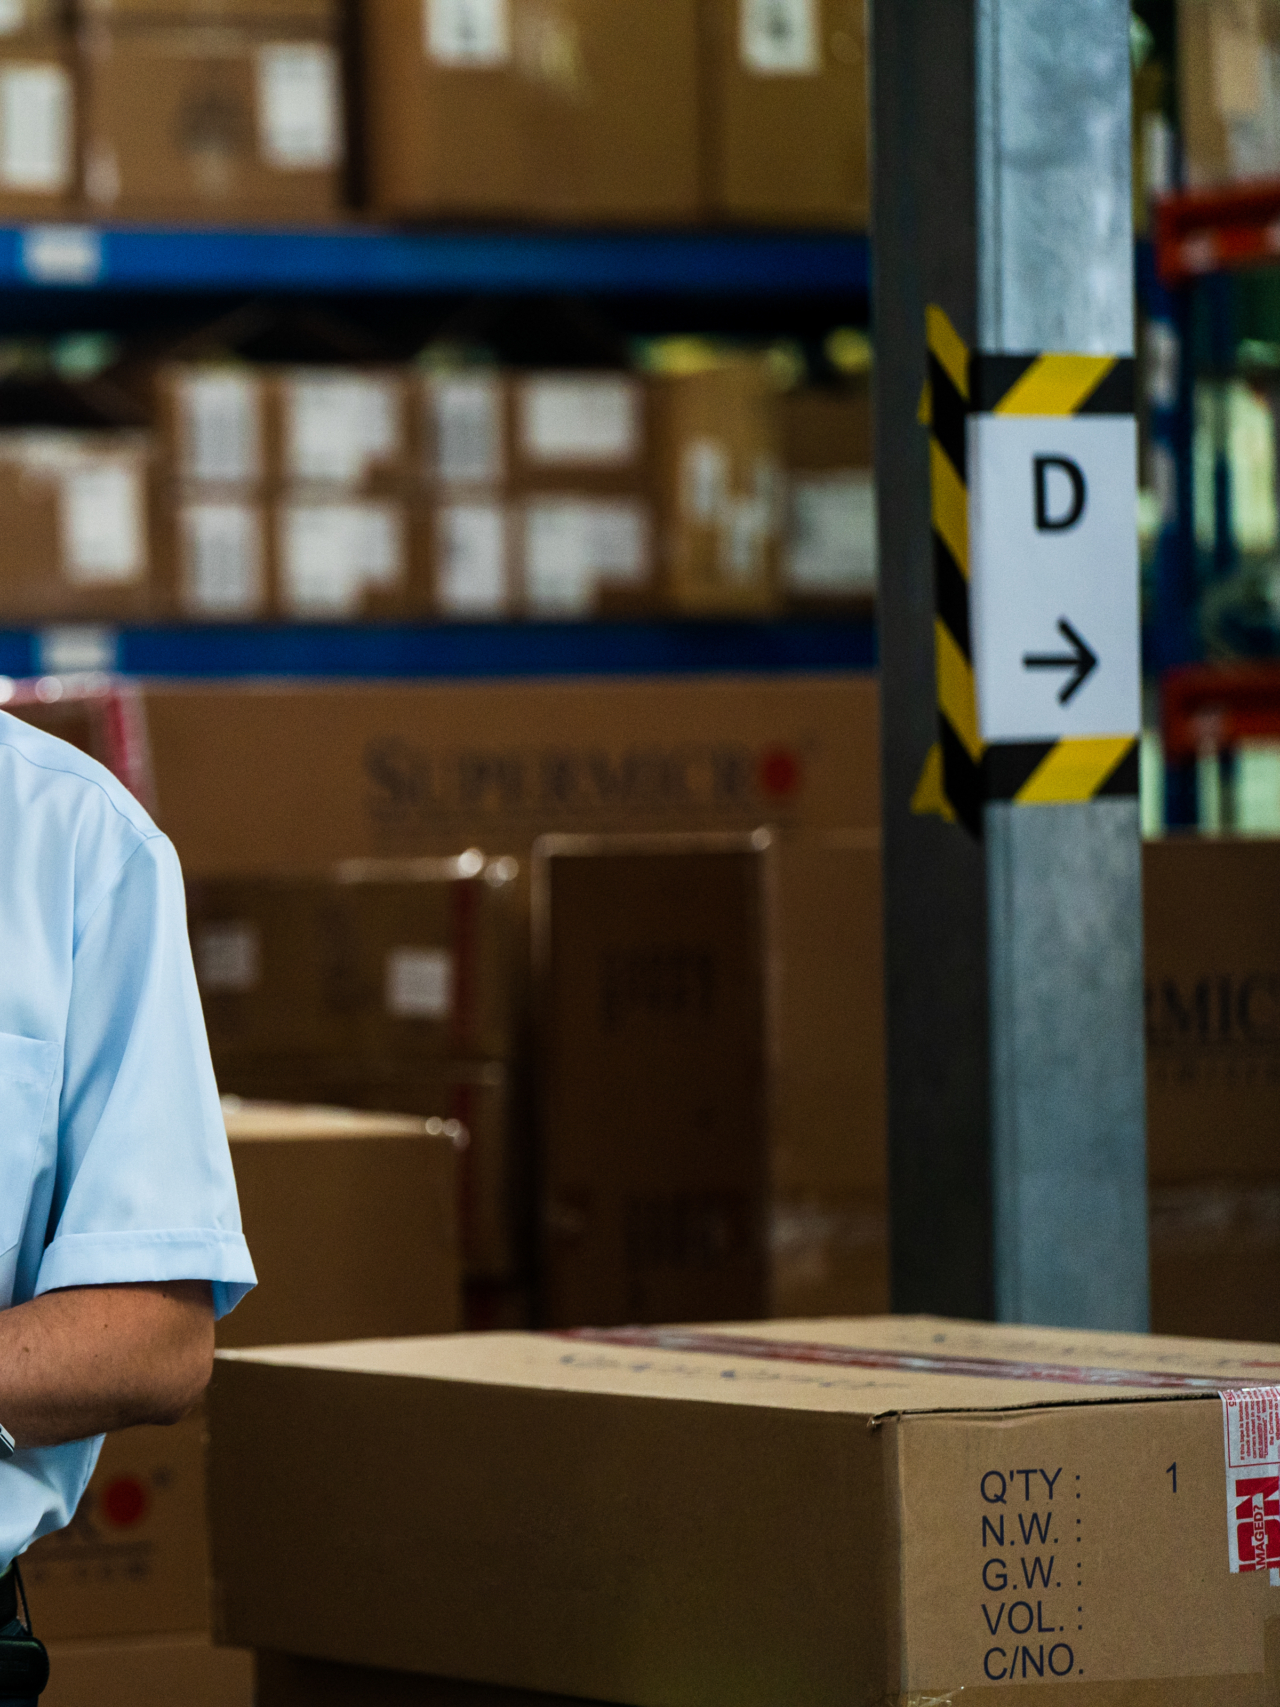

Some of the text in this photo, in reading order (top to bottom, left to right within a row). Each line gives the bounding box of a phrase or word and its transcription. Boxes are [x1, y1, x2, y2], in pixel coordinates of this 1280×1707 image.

[1033, 454, 1087, 532] D
[980, 1468, 1063, 1504] Q'TY
[1166, 1461, 1177, 1493] 1
[982, 1512, 1059, 1547] N.W.
[981, 1555, 1062, 1591] G.W.
[981, 1600, 1065, 1635] VOL.
[983, 1643, 1085, 1680] C/NO.
